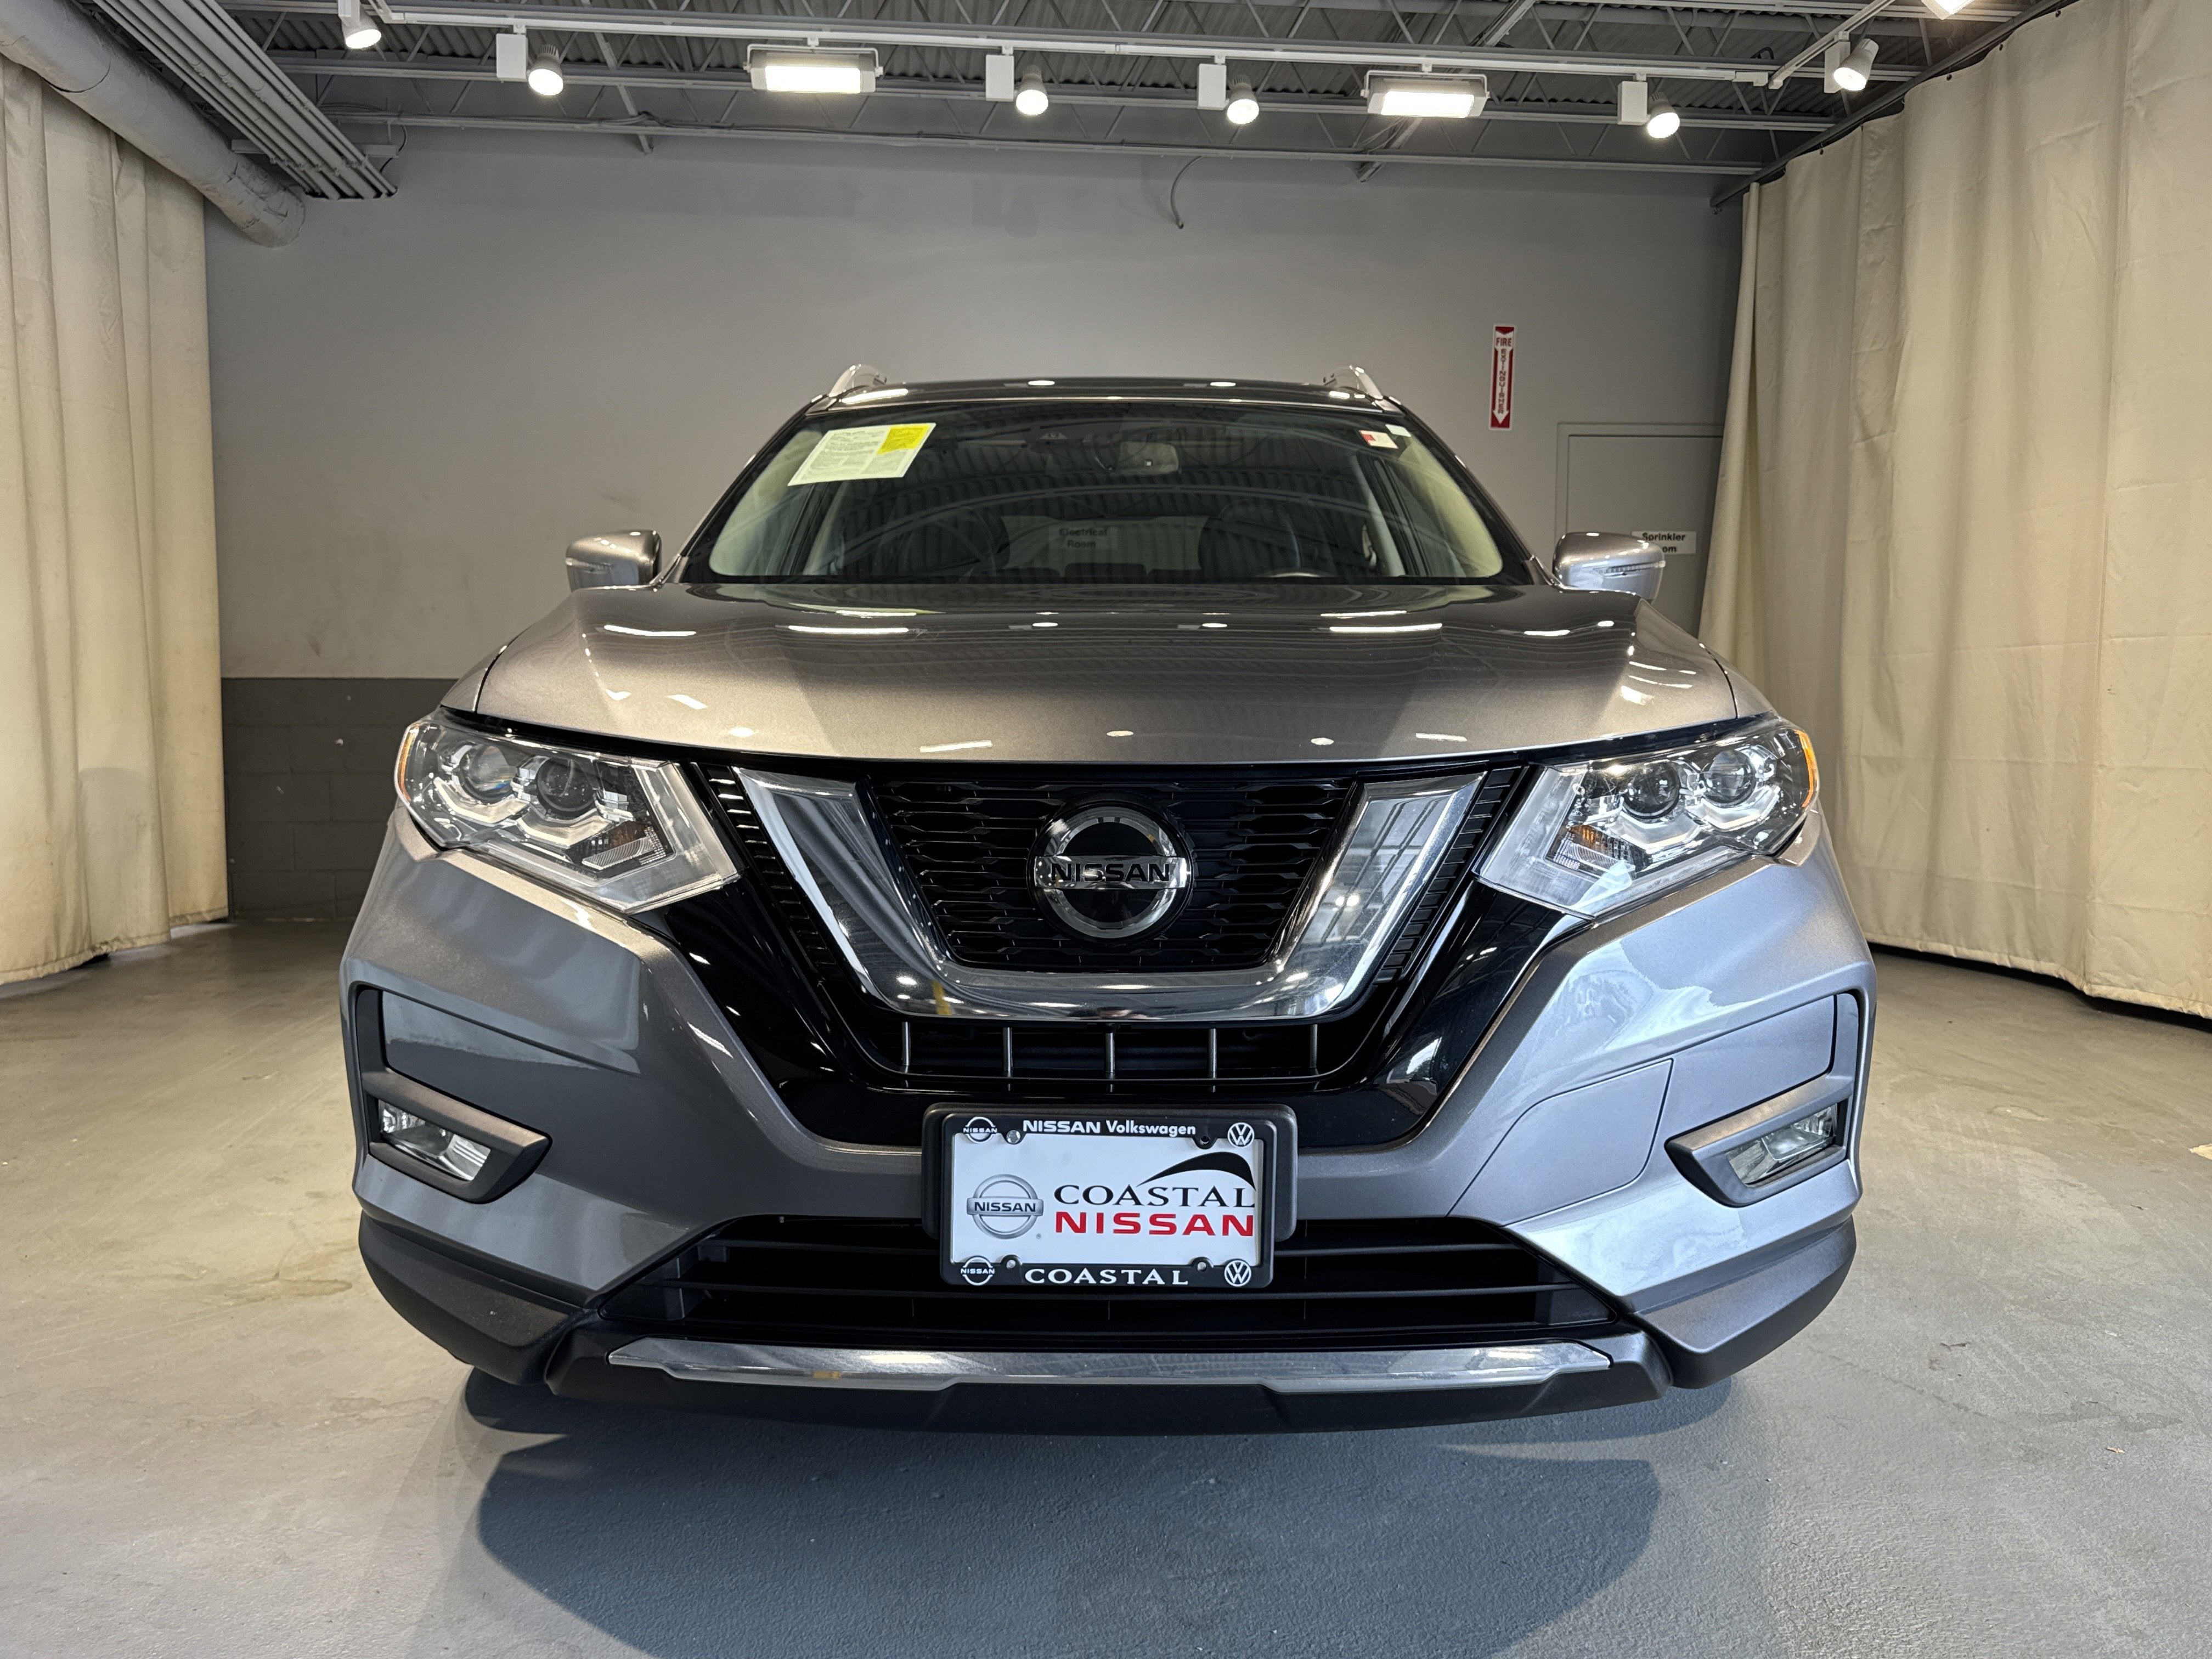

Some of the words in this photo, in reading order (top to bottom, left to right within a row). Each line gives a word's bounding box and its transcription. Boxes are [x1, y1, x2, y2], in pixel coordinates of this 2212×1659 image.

[1496, 337, 1512, 347] FIRE
[1498, 349, 1506, 414] EXTINGUISHER
[1059, 528, 1107, 537] Electrical
[1642, 532, 1686, 541] Sprinkler
[1067, 540, 1096, 548] Room
[1050, 863, 1170, 882] NISSAN
[1023, 1120, 1100, 1133] NISSAN
[1106, 1120, 1196, 1137] Volkswagen
[1054, 1184, 1255, 1207] COASTAL
[974, 1201, 1036, 1212] NISSAN
[1056, 1211, 1254, 1237] NISSAN
[1025, 1267, 1188, 1285] COASTAL
